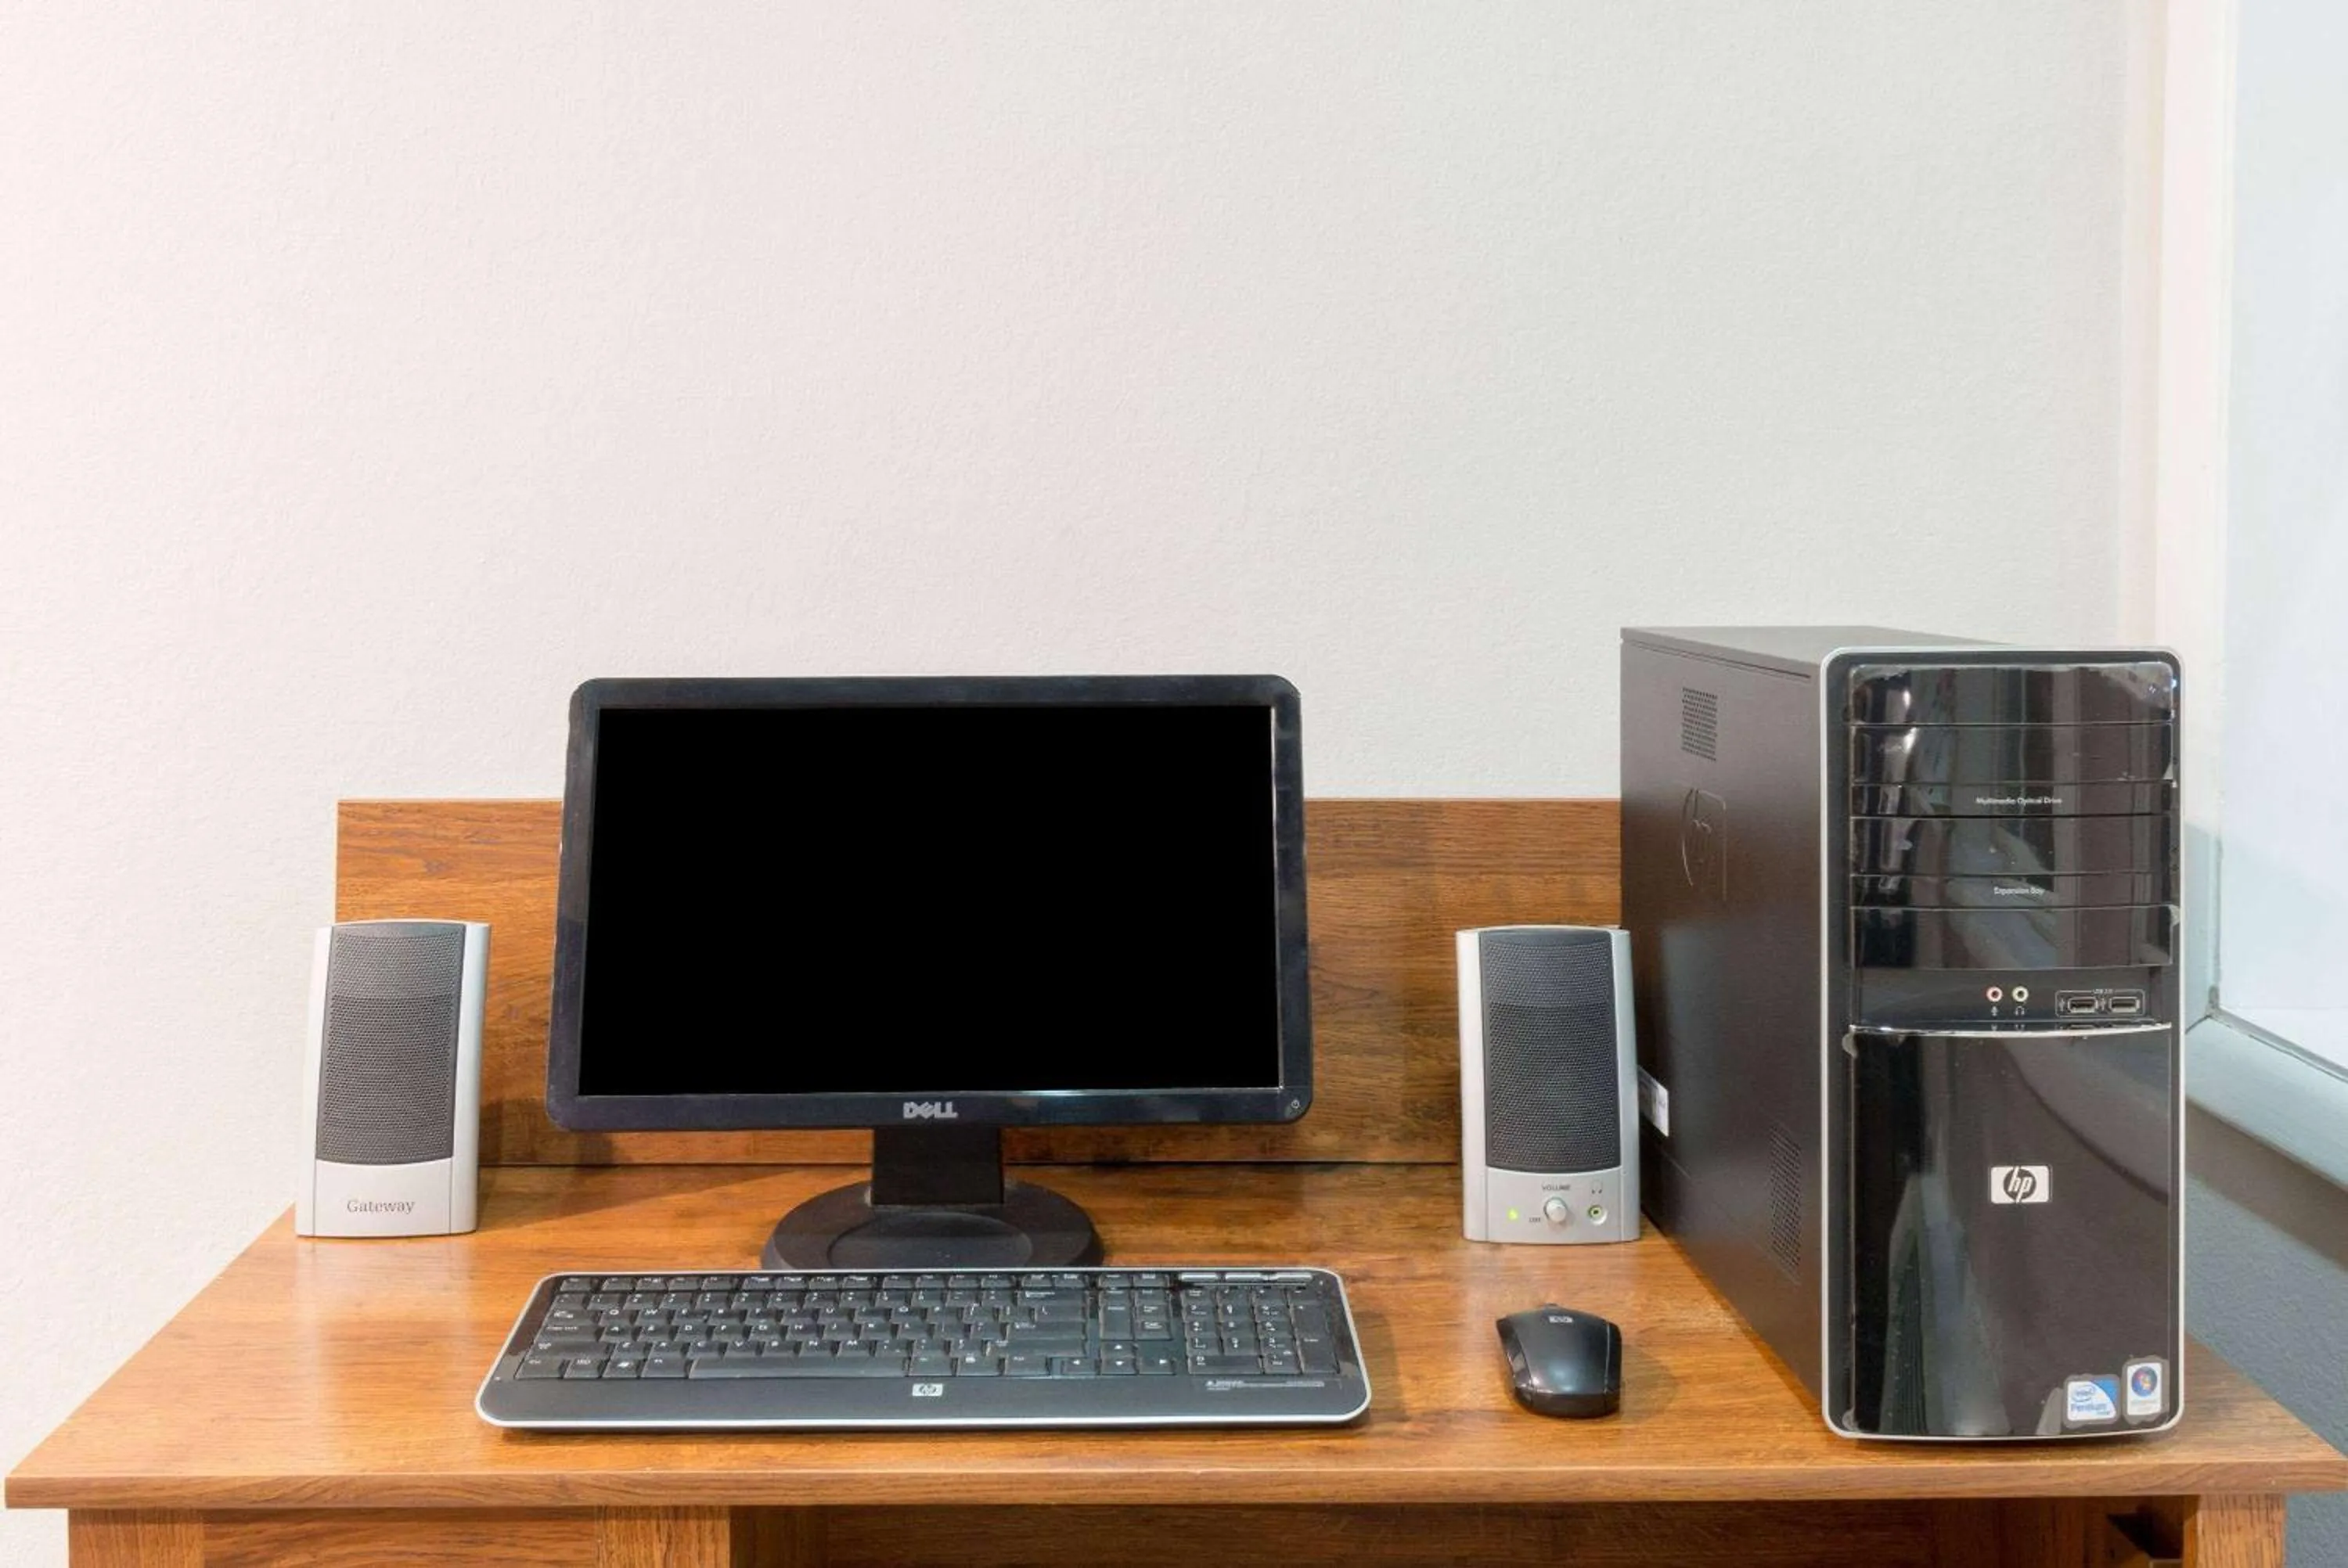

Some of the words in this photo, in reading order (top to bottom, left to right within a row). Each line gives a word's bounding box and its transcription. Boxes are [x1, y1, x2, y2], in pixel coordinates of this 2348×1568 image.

[2018, 797, 2041, 805] Optical
[1993, 886, 2029, 895] Expansion
[2030, 886, 2045, 896] Bay
[902, 1101, 958, 1119] DELL
[2008, 1165, 2033, 1203] hp
[347, 1199, 415, 1214] Gateway
